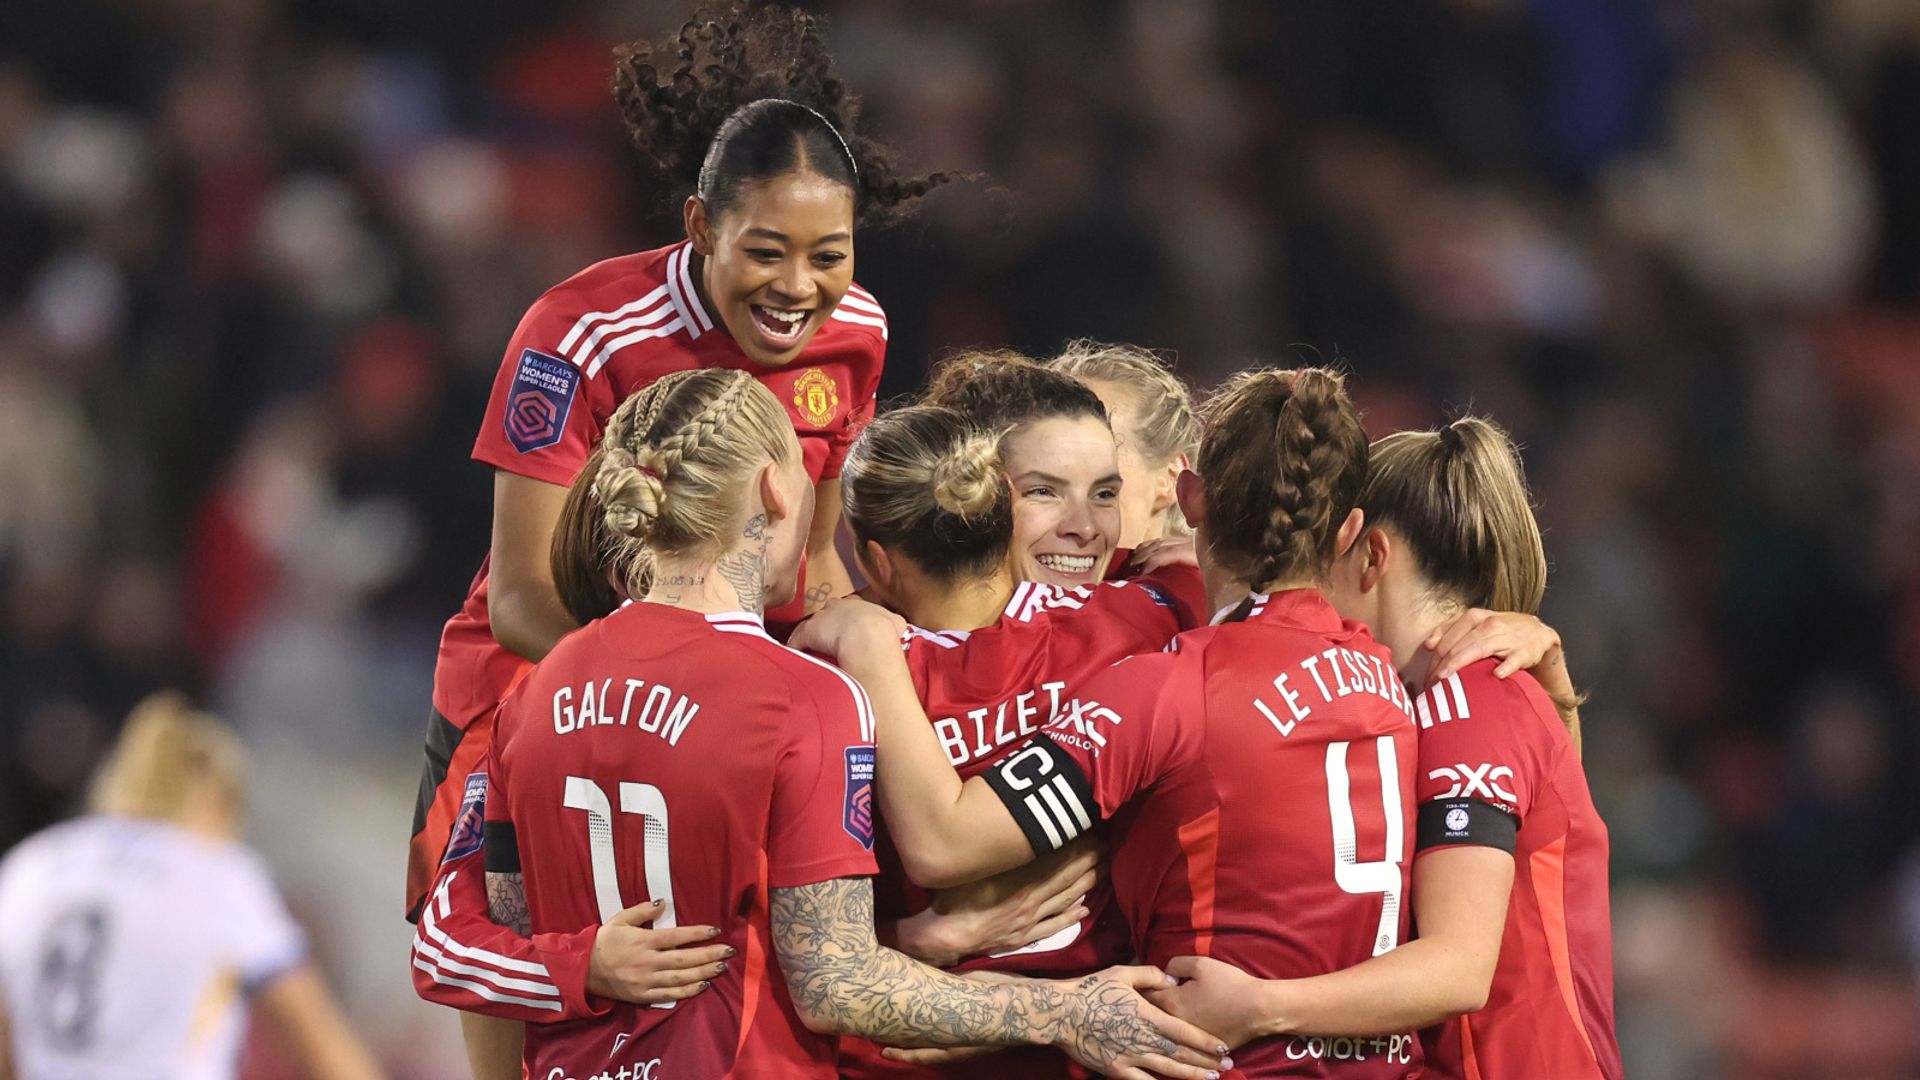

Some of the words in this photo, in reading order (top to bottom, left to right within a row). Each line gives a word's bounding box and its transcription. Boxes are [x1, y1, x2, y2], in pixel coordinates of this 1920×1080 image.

[519, 374, 539, 386] SUPER
[539, 381, 567, 395] LEAGUE
[522, 365, 569, 388] WOMEN'S
[531, 359, 573, 380] BARCLAYS
[553, 678, 700, 747] GALTON
[1253, 672, 1312, 737] LE
[1001, 746, 1054, 791] C
[1428, 763, 1517, 803] DXC
[1325, 735, 1404, 957] 4
[563, 775, 678, 1009] 11
